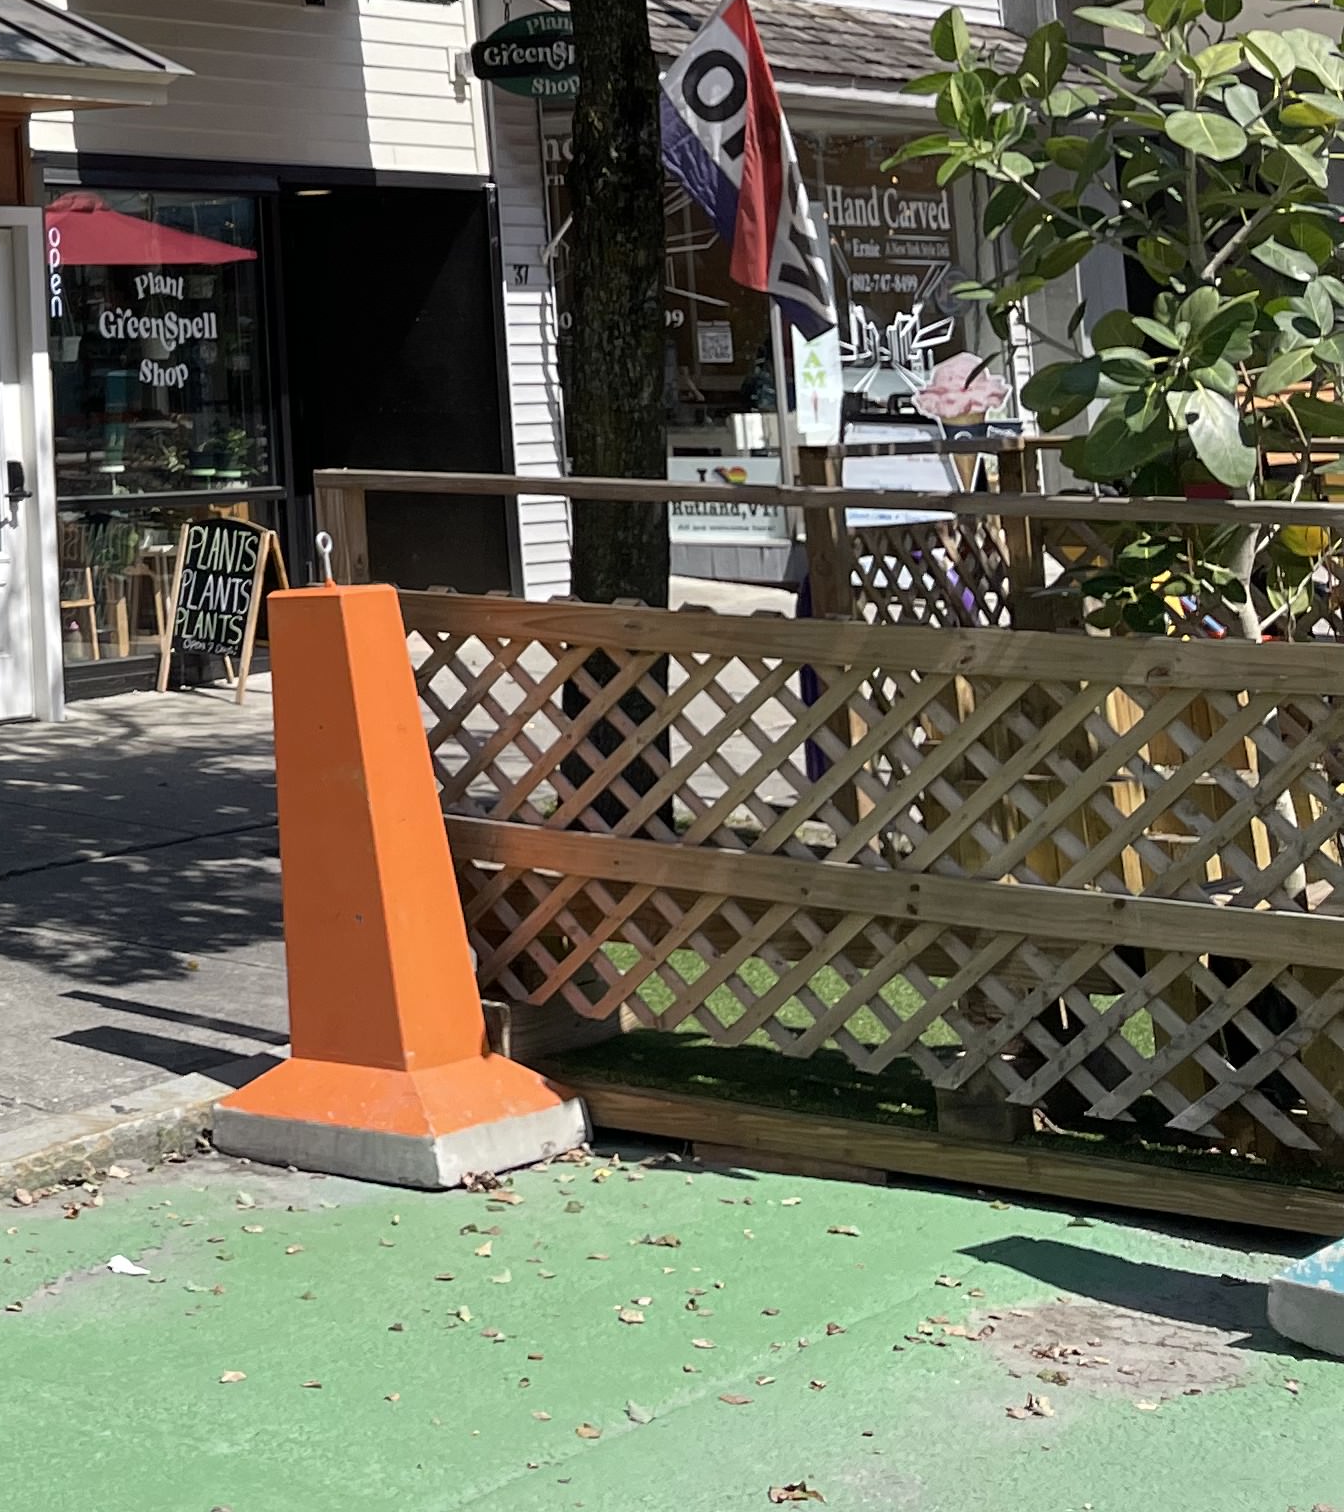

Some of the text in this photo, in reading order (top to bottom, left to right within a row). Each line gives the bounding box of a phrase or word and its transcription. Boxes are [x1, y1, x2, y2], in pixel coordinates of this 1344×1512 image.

[826, 185, 951, 230] Hand Carved
[852, 239, 881, 257] Ernie
[134, 272, 185, 301] Plant
[513, 264, 529, 286] 37
[99, 306, 217, 351] GreenSpell
[138, 358, 189, 389] Shop
[186, 525, 259, 574] PLANTS
[179, 568, 252, 615] PLANTS
[174, 606, 243, 645] PLANTS
